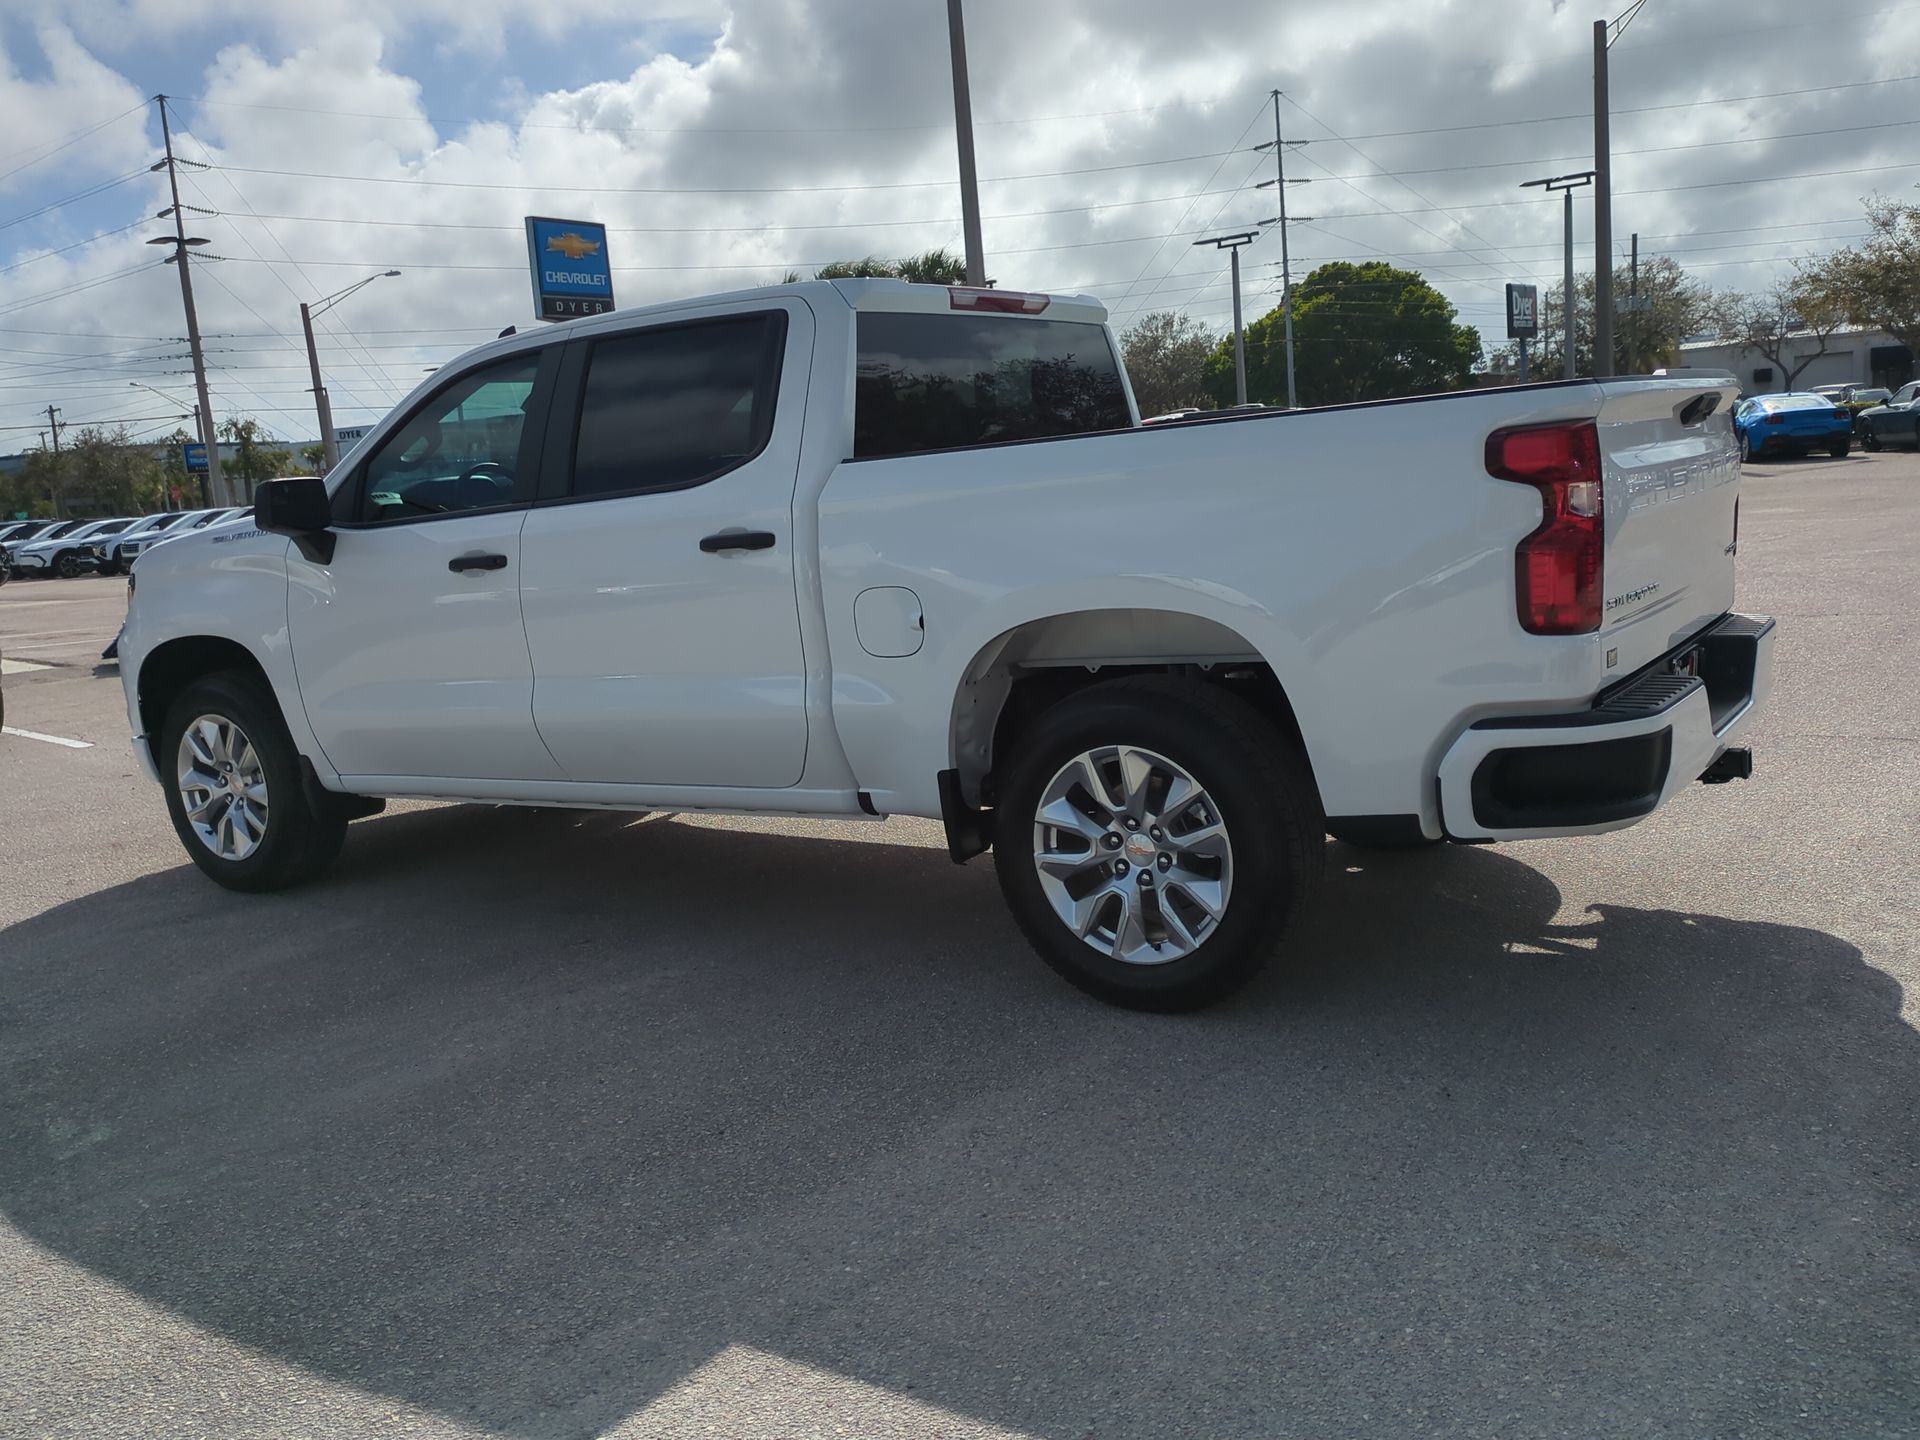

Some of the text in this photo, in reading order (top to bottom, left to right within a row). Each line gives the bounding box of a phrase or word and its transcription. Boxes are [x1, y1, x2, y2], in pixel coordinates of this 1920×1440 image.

[545, 271, 607, 286] CHEVROLET
[556, 301, 603, 313] DYER
[339, 430, 362, 440] DYER
